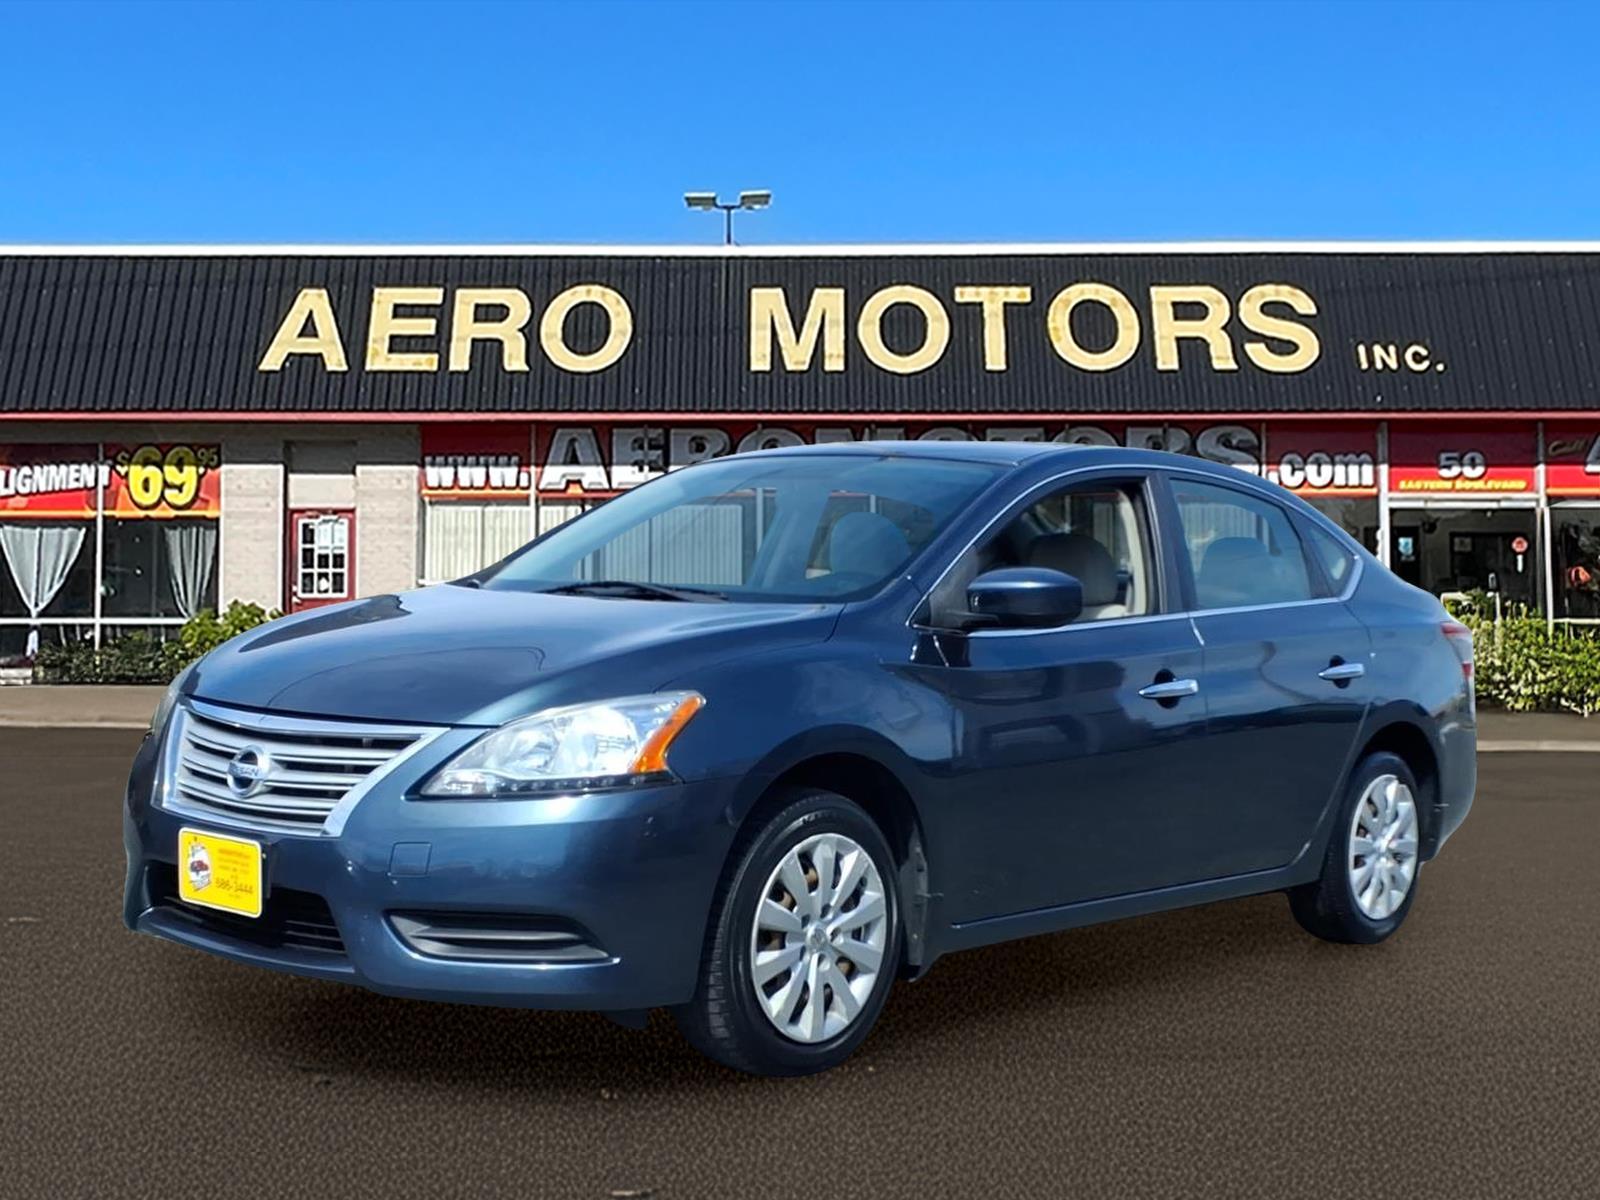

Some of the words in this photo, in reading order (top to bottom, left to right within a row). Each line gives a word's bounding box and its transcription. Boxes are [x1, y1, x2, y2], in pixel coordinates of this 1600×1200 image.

[257, 284, 633, 373] AERO
[750, 283, 1321, 374] MOTORS
[1357, 344, 1445, 371] INC.
[1438, 452, 1486, 479] 50
[1455, 480, 1527, 490] BOULEVARD
